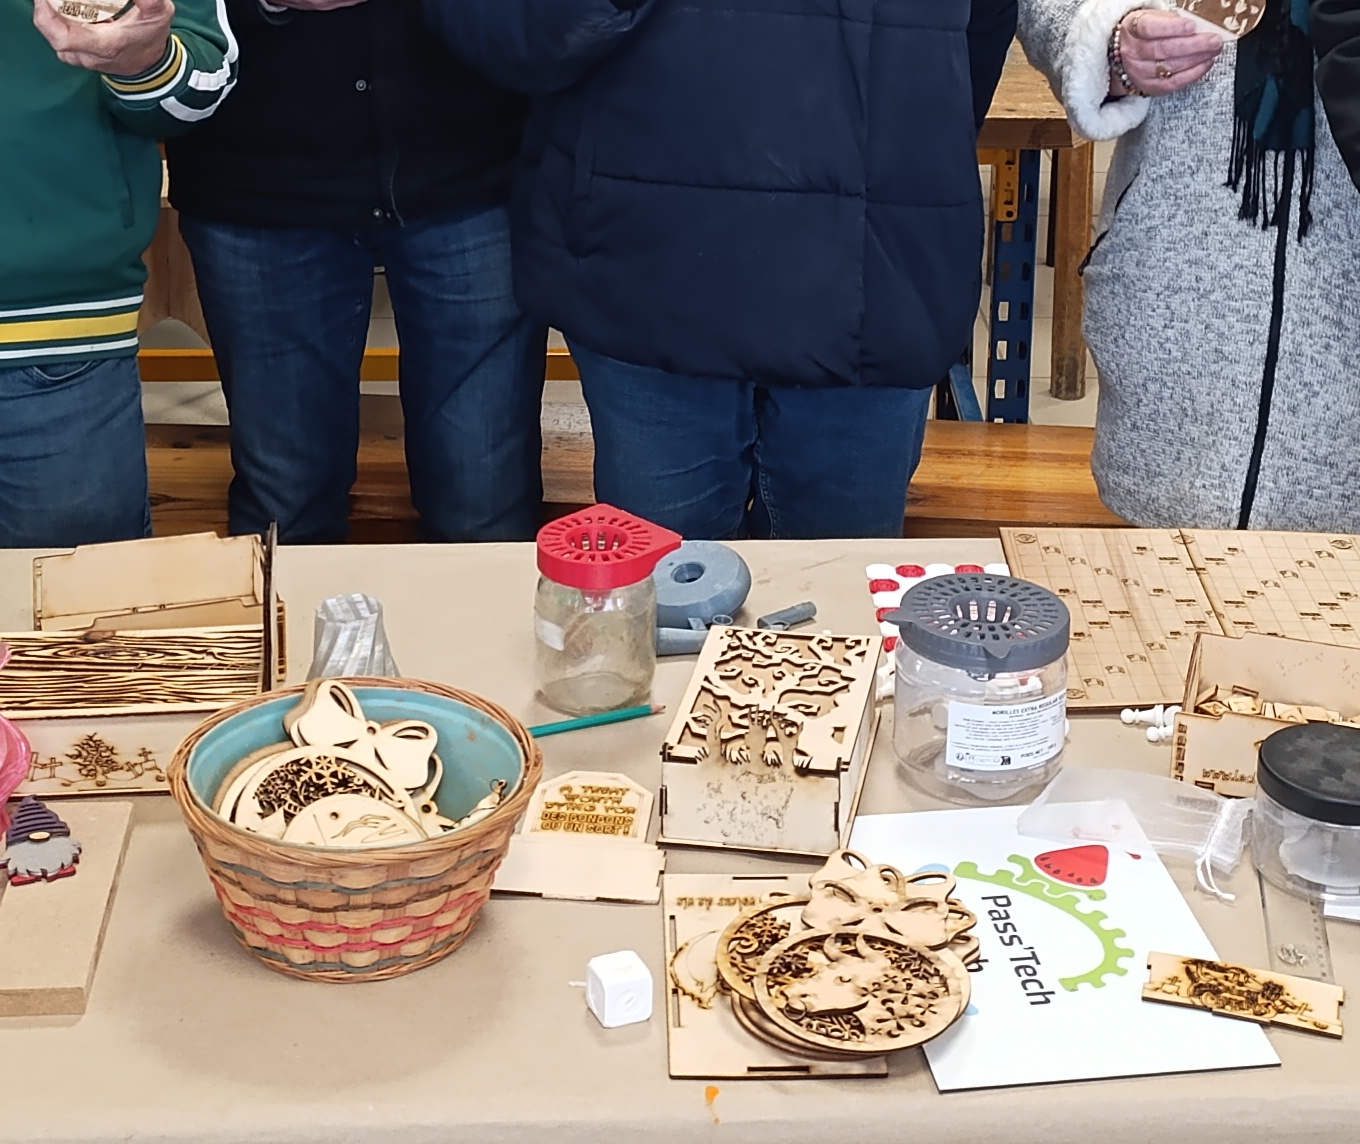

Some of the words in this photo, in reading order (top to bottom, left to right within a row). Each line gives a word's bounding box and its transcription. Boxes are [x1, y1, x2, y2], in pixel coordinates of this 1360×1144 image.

[1021, 704, 1038, 714] EXTRA
[541, 811, 567, 822] DES
[568, 813, 634, 826] BONBONS
[540, 822, 562, 831] OU
[563, 822, 585, 833] UN
[980, 894, 1057, 1006] Pass'Tech
